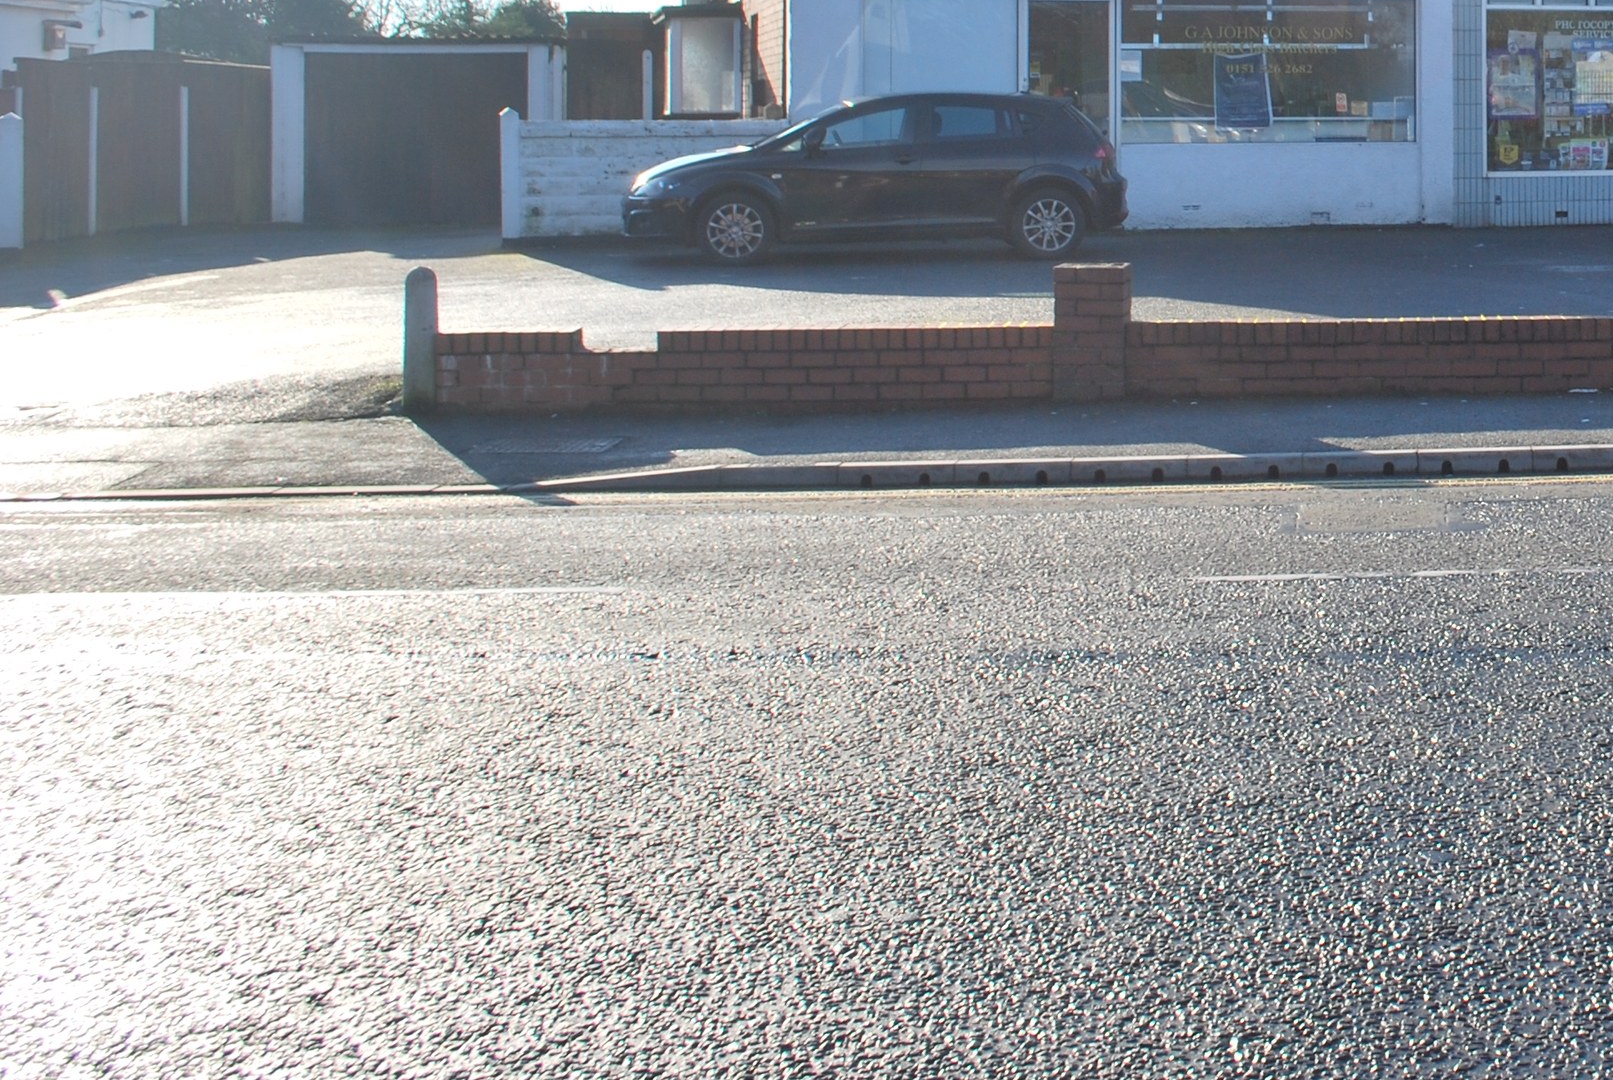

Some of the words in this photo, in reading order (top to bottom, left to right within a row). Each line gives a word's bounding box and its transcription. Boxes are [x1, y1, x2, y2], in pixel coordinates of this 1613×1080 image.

[1184, 25, 1197, 39] G
[1201, 26, 1213, 39] A
[1218, 26, 1293, 39] JOHNSON
[1297, 26, 1306, 39] &
[1313, 27, 1353, 40] SONS
[1202, 41, 1235, 55] High
[1239, 41, 1276, 54] Class
[1280, 41, 1338, 54] Butchers
[1226, 64, 1255, 74] 0151
[1285, 64, 1313, 74] 2682
